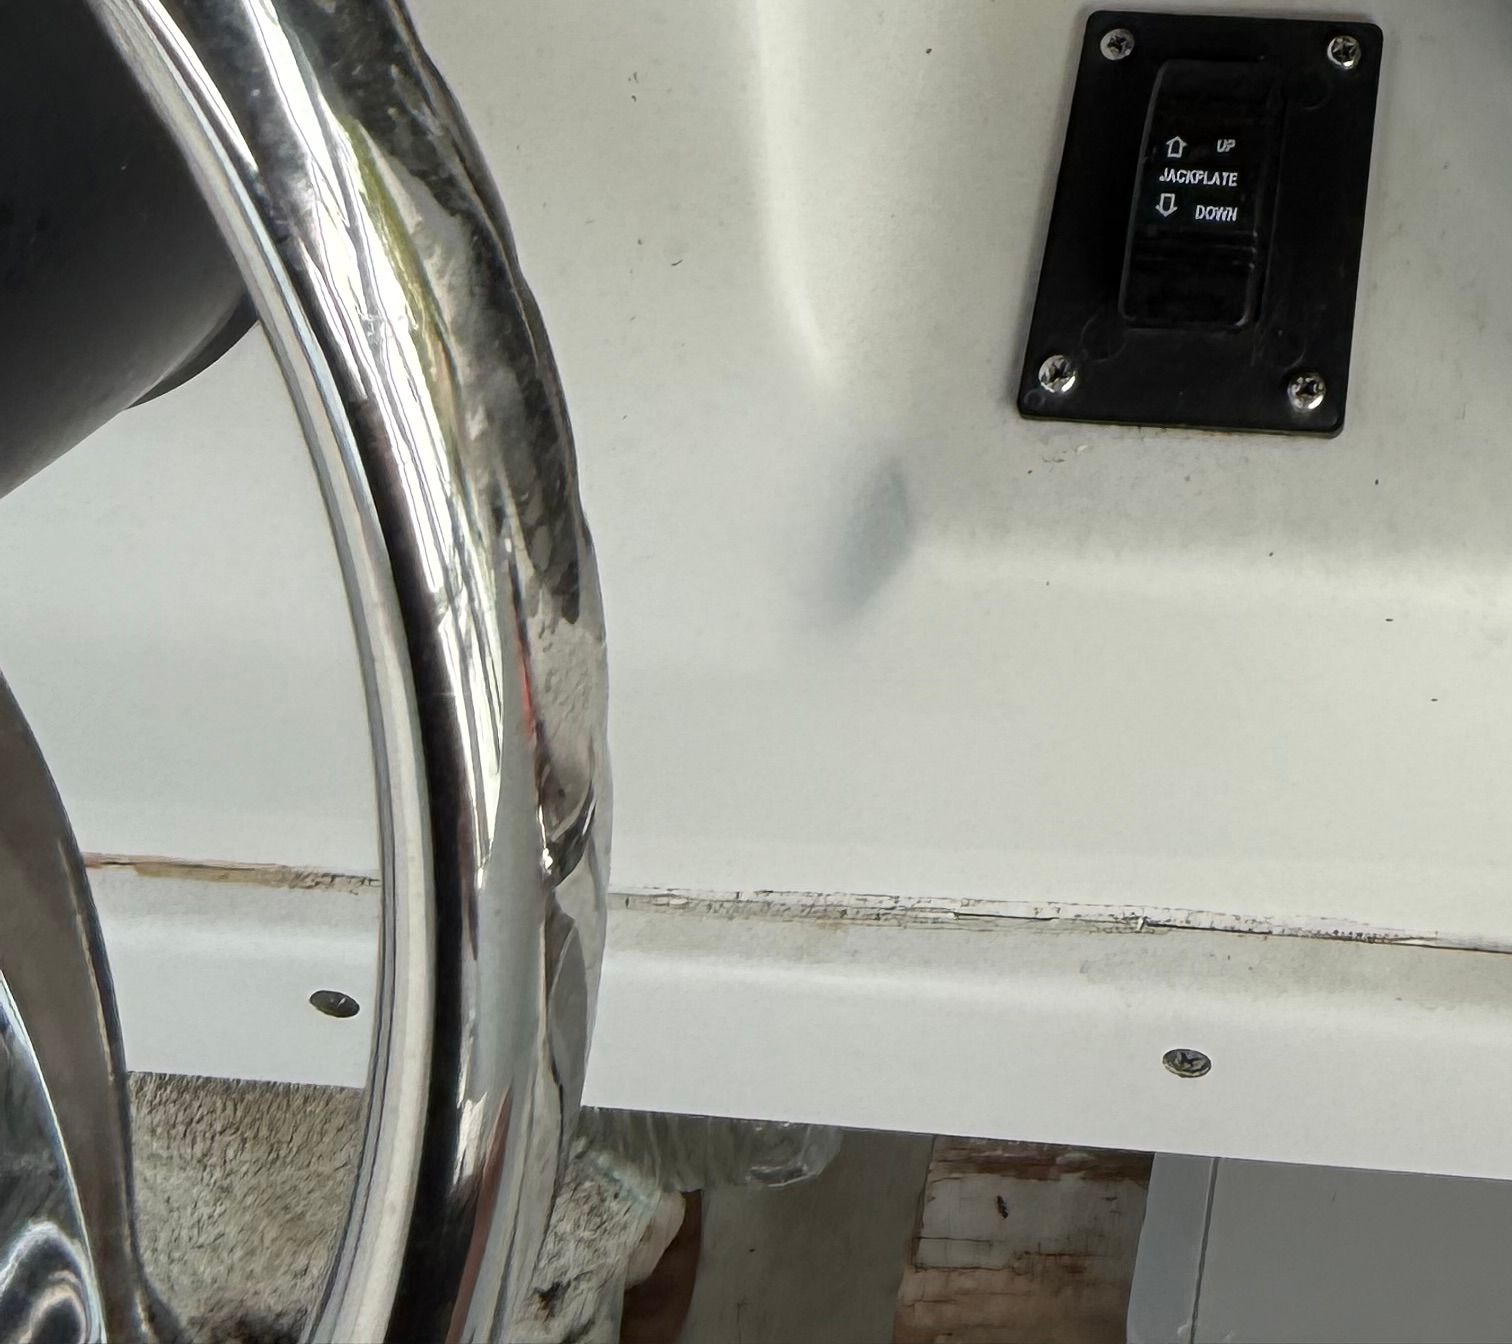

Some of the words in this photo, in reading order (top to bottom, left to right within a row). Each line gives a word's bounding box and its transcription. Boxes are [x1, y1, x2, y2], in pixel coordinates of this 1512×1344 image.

[1217, 139, 1236, 153] UP
[1159, 167, 1238, 187] JACKPLATE
[1195, 205, 1238, 222] DOWN
